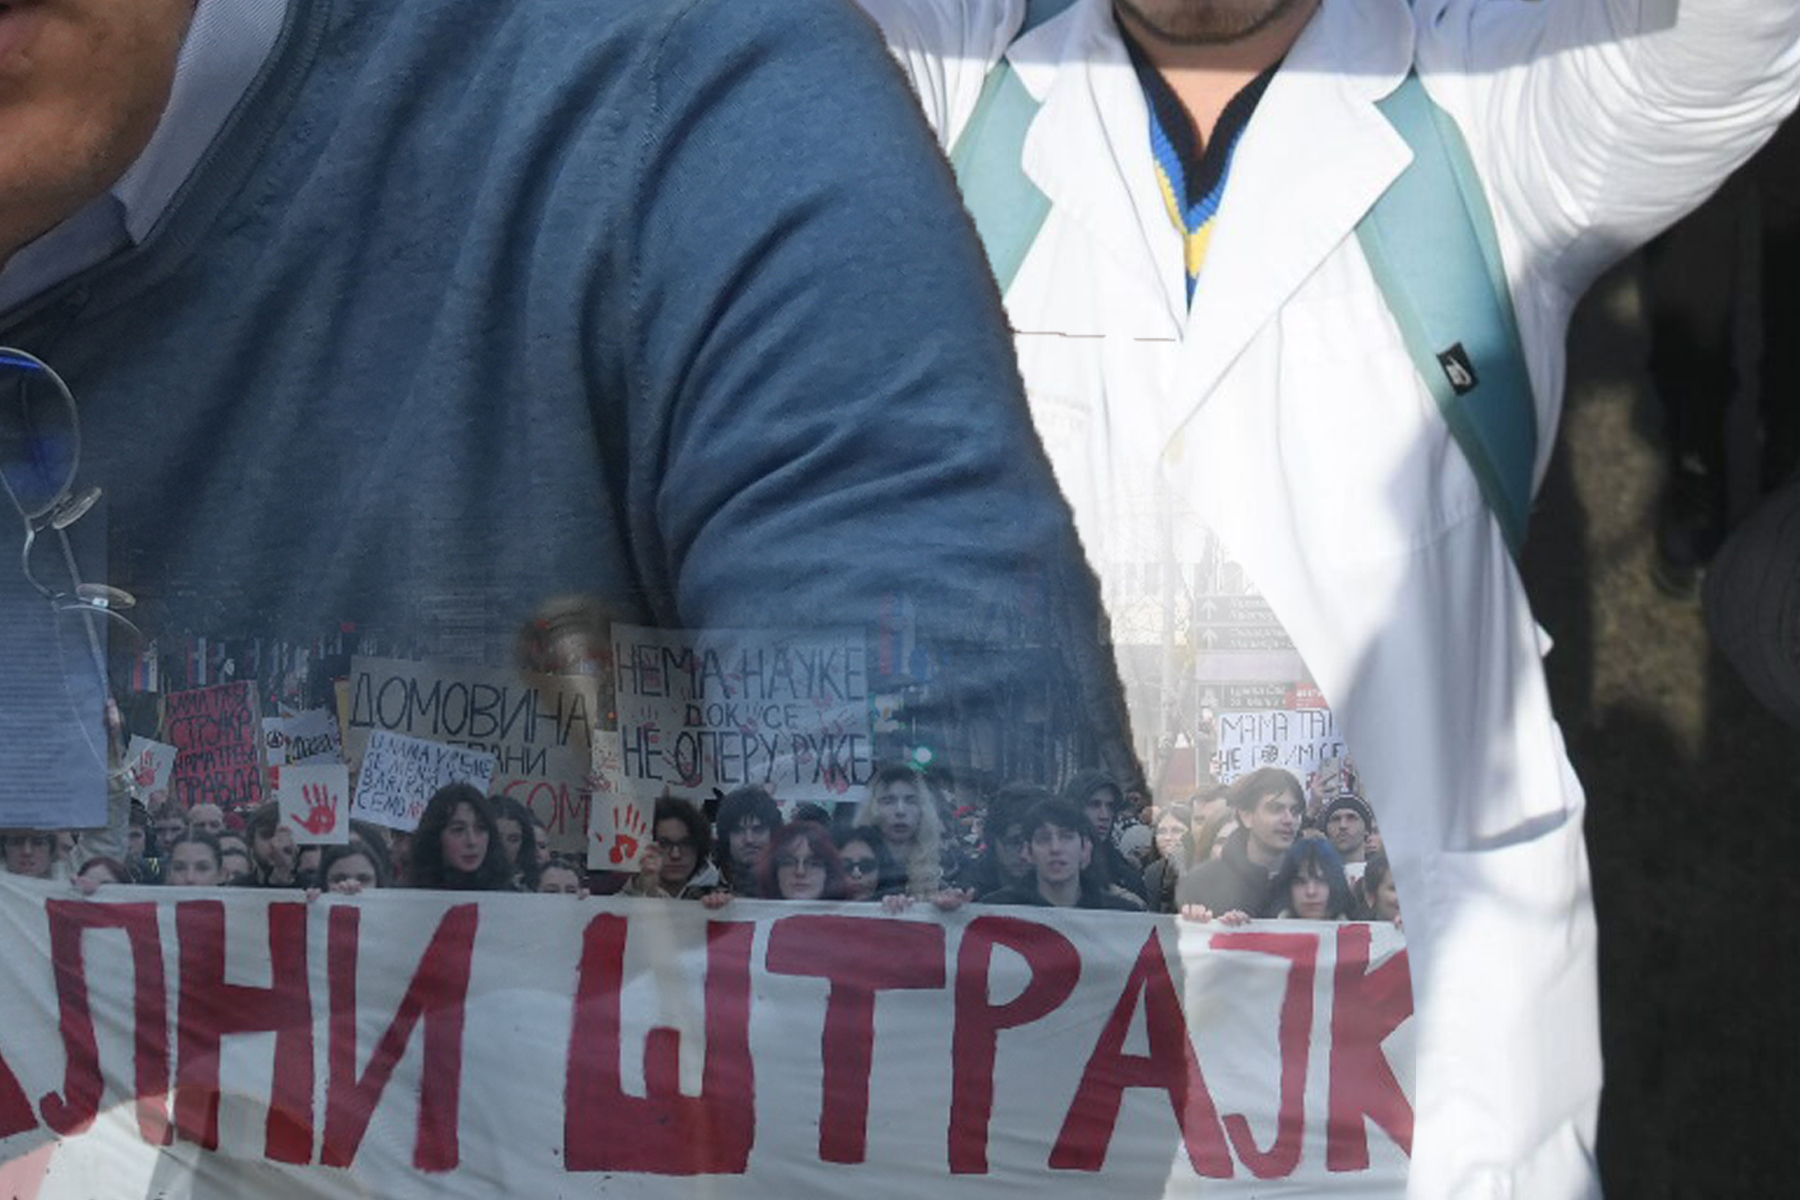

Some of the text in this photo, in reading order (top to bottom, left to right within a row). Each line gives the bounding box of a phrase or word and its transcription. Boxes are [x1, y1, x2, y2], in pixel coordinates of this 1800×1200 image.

[615, 643, 865, 701] НЕМА НАУКЕ
[350, 673, 592, 748] ДОМОВИНА
[684, 703, 802, 730] ДОК СЕ
[622, 725, 663, 781] НЕ
[675, 730, 780, 785] ОПЕРУ
[792, 732, 877, 786] РУКЕ
[563, 912, 1414, 1180] ШТРАЈК
